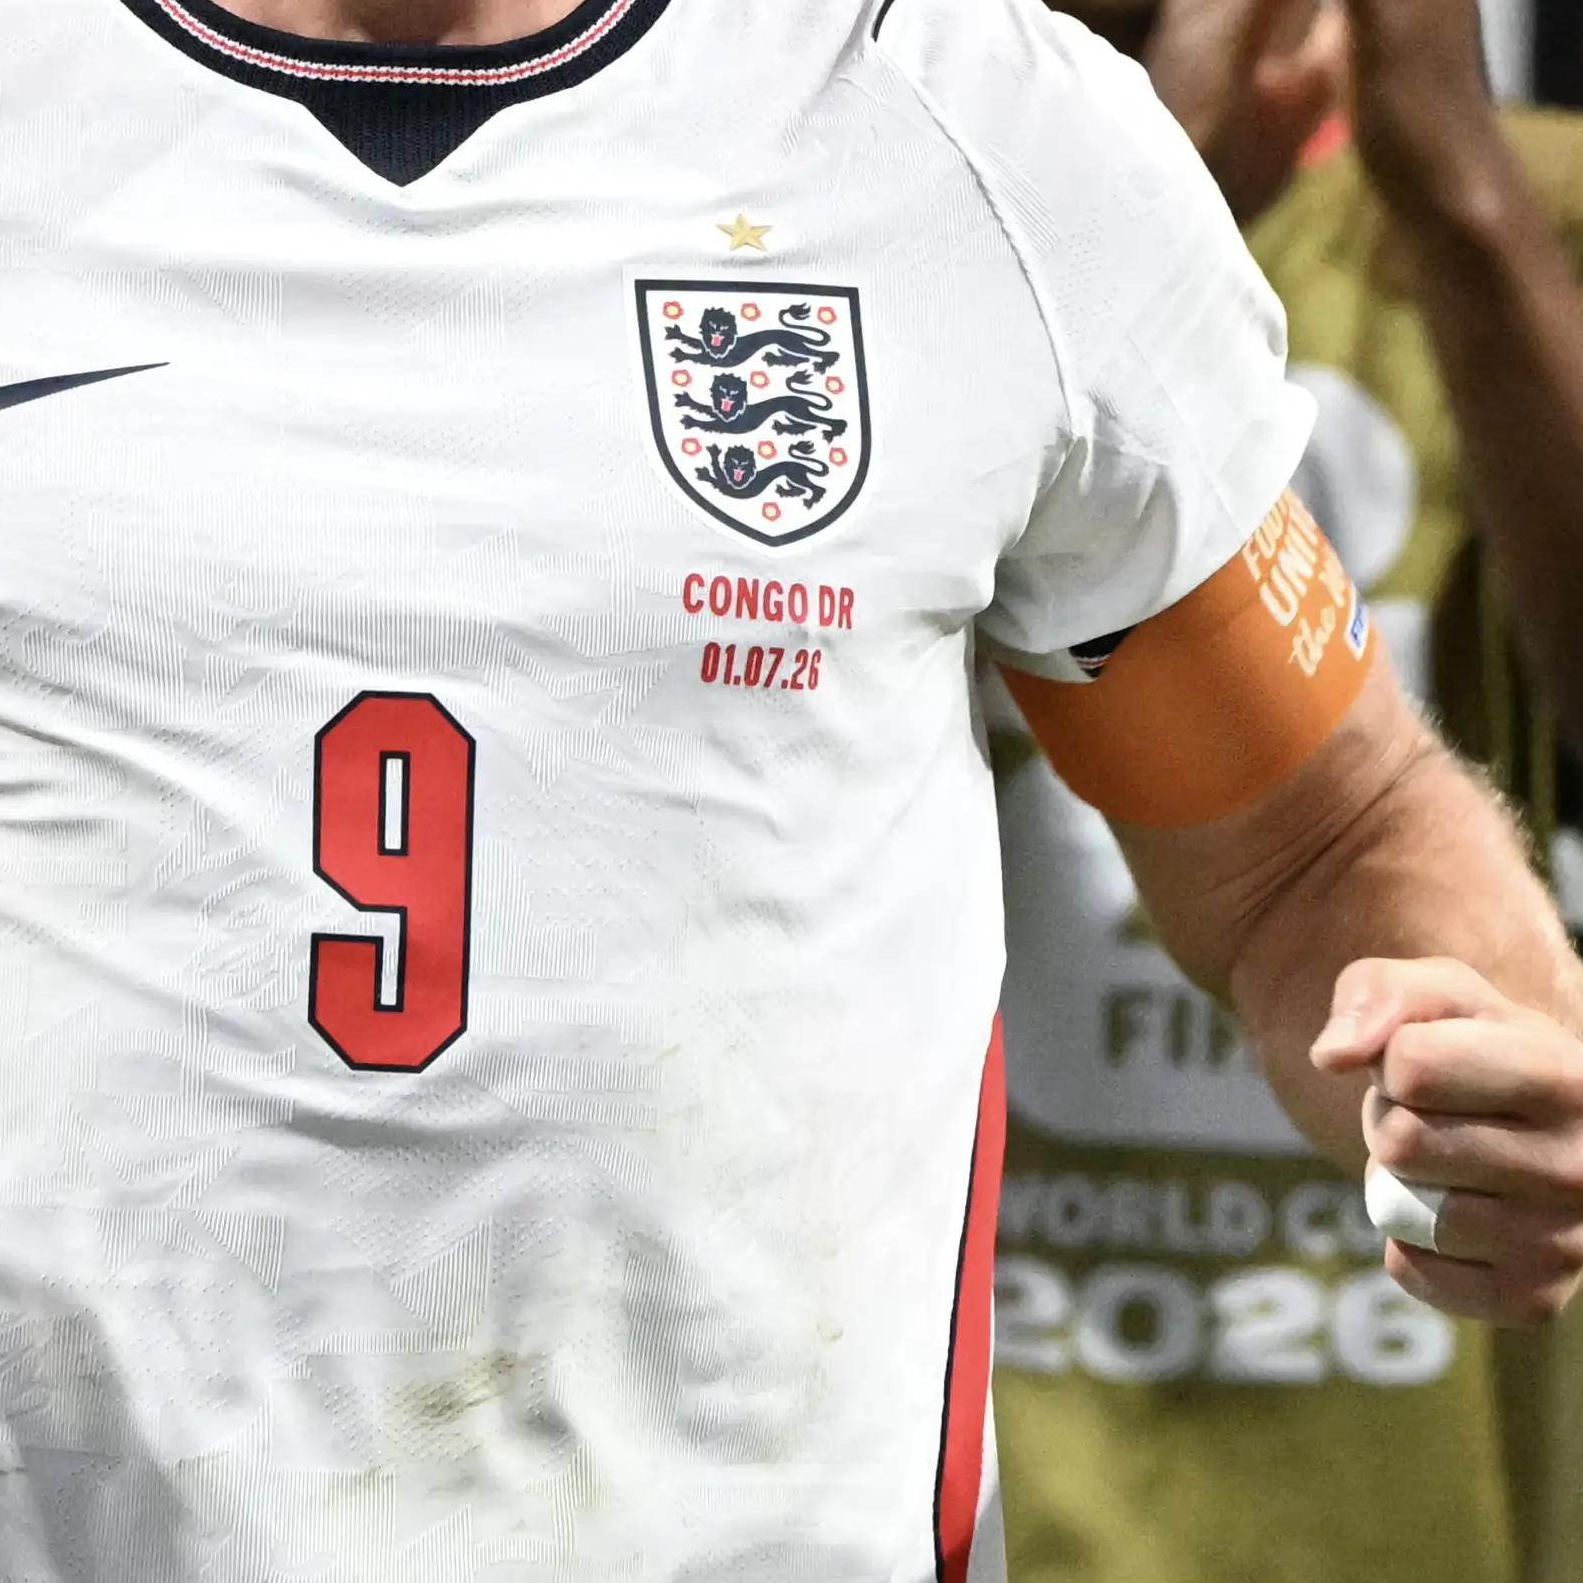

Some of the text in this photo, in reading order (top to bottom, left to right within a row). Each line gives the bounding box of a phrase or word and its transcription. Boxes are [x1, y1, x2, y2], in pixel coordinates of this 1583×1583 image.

[682, 572, 855, 630] CONGO DR
[700, 641, 822, 691] 01.07.26
[306, 688, 476, 1074] 9
[992, 1254, 1456, 1387] 2026
